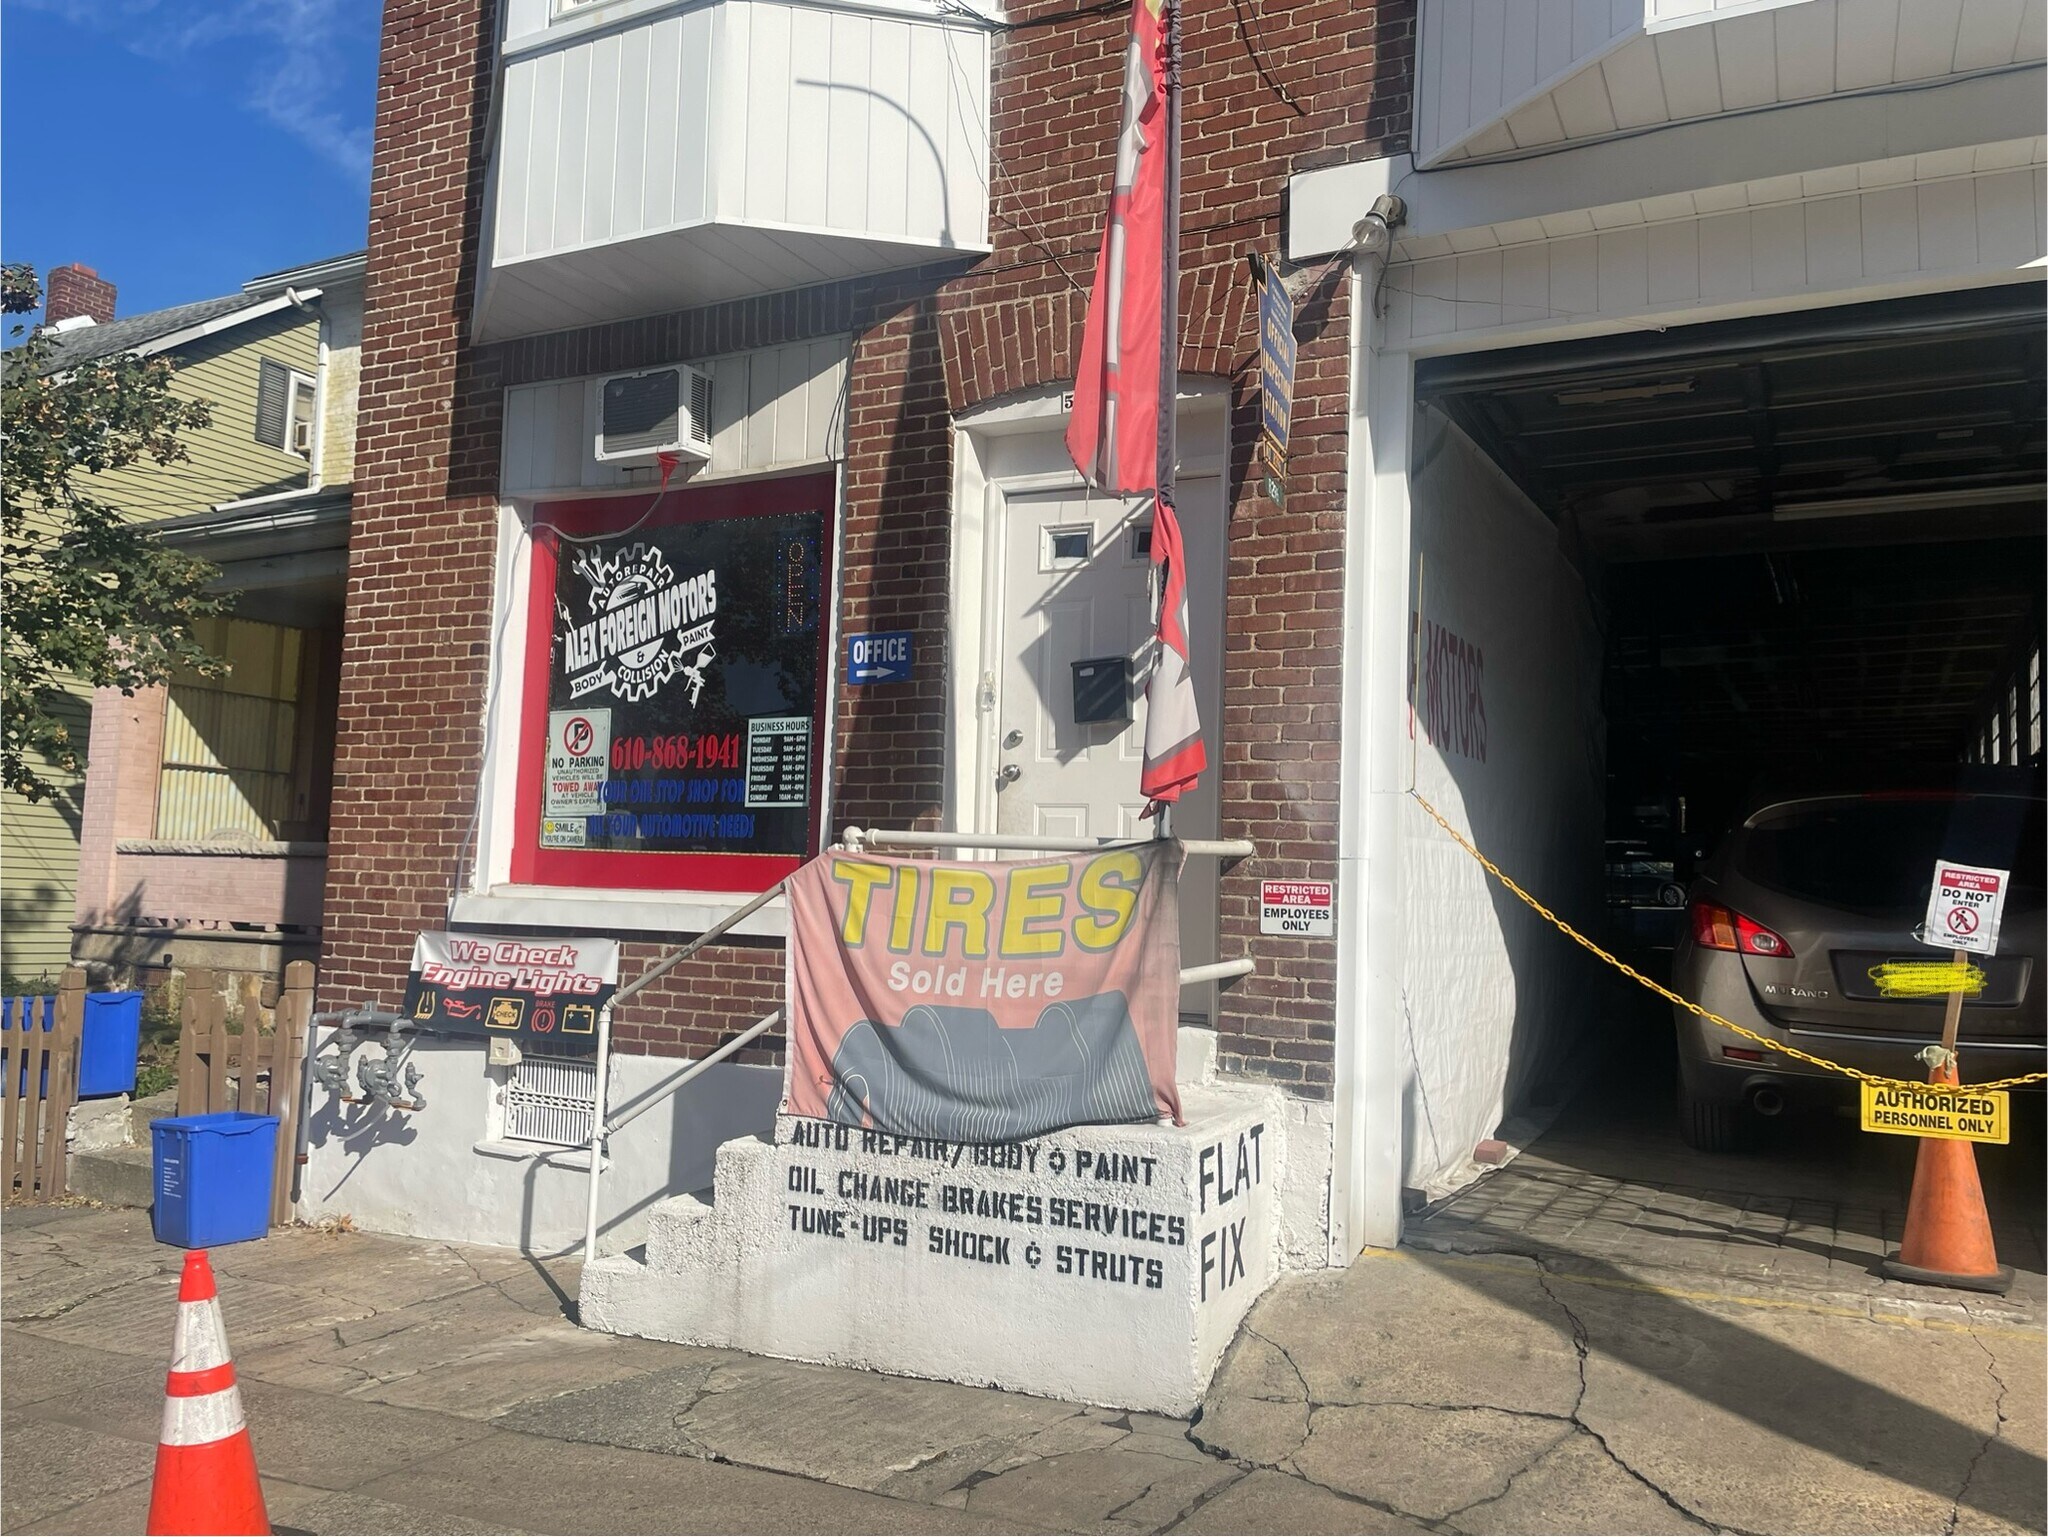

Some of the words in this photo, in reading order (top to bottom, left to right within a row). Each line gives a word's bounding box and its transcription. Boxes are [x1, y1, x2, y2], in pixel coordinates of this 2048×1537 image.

[1265, 388, 1286, 433] STATION
[787, 542, 804, 628] OPEN
[565, 621, 597, 674] ALEX
[600, 595, 657, 659] FOREIGN
[658, 569, 717, 634] MOTORS
[574, 672, 603, 692] BODY
[617, 649, 670, 684] COLLISION
[683, 628, 709, 646] PAINT
[636, 651, 645, 663] &
[853, 638, 907, 664] OFFICE
[1426, 619, 1487, 765] MOTORS
[751, 721, 784, 732] BUSINESS
[785, 720, 810, 731] HOURS
[552, 758, 565, 768] NO
[569, 756, 604, 768] PARKING
[611, 734, 740, 770] 610-868-1941
[552, 782, 580, 793] TOWED
[654, 779, 685, 803] STOP
[687, 779, 719, 803] SHOP
[555, 823, 575, 833] SMILE
[641, 814, 716, 838] AUTOMOTIVE
[718, 814, 755, 839] NEEDS
[1265, 884, 1329, 895] RESTRICTED
[1944, 872, 1996, 884] RESTRICTED
[1958, 881, 1980, 889] AREA
[831, 850, 1146, 960] TIRES
[1282, 895, 1311, 904] AREA
[1942, 888, 1961, 898] DO
[1966, 892, 1993, 903] NOT
[1952, 899, 1980, 908] ENTER
[1264, 908, 1329, 920] EMPLOYEES
[1282, 920, 1311, 931] ONLY
[1943, 933, 1978, 942] EMPLOYEES
[450, 940, 490, 963] We
[494, 942, 578, 969] Check
[420, 962, 511, 991] Engine
[512, 968, 602, 997] Lights
[887, 961, 967, 997] Sold
[979, 968, 1064, 998] Here
[1765, 985, 1829, 999] MURANO
[496, 1010, 517, 1019] CHECK
[1875, 1091, 1995, 1117] AUTHORIZED
[1874, 1111, 1953, 1130] PERSONNEL
[1958, 1118, 1994, 1134] ONLY
[792, 1120, 849, 1151] AUTO
[973, 1141, 1041, 1173] BODY
[1076, 1150, 1157, 1186] PAINT
[1200, 1123, 1265, 1215] FLAT
[788, 1166, 824, 1195] OIL
[838, 1170, 930, 1208] CHANGE
[942, 1185, 1043, 1225] BRAKES
[1050, 1197, 1186, 1246] SERVICES
[788, 1205, 908, 1247] TUNE-UPS
[929, 1226, 1011, 1265] SHOCK
[1057, 1245, 1163, 1289] STRUTS
[1201, 1216, 1246, 1303] FIX
